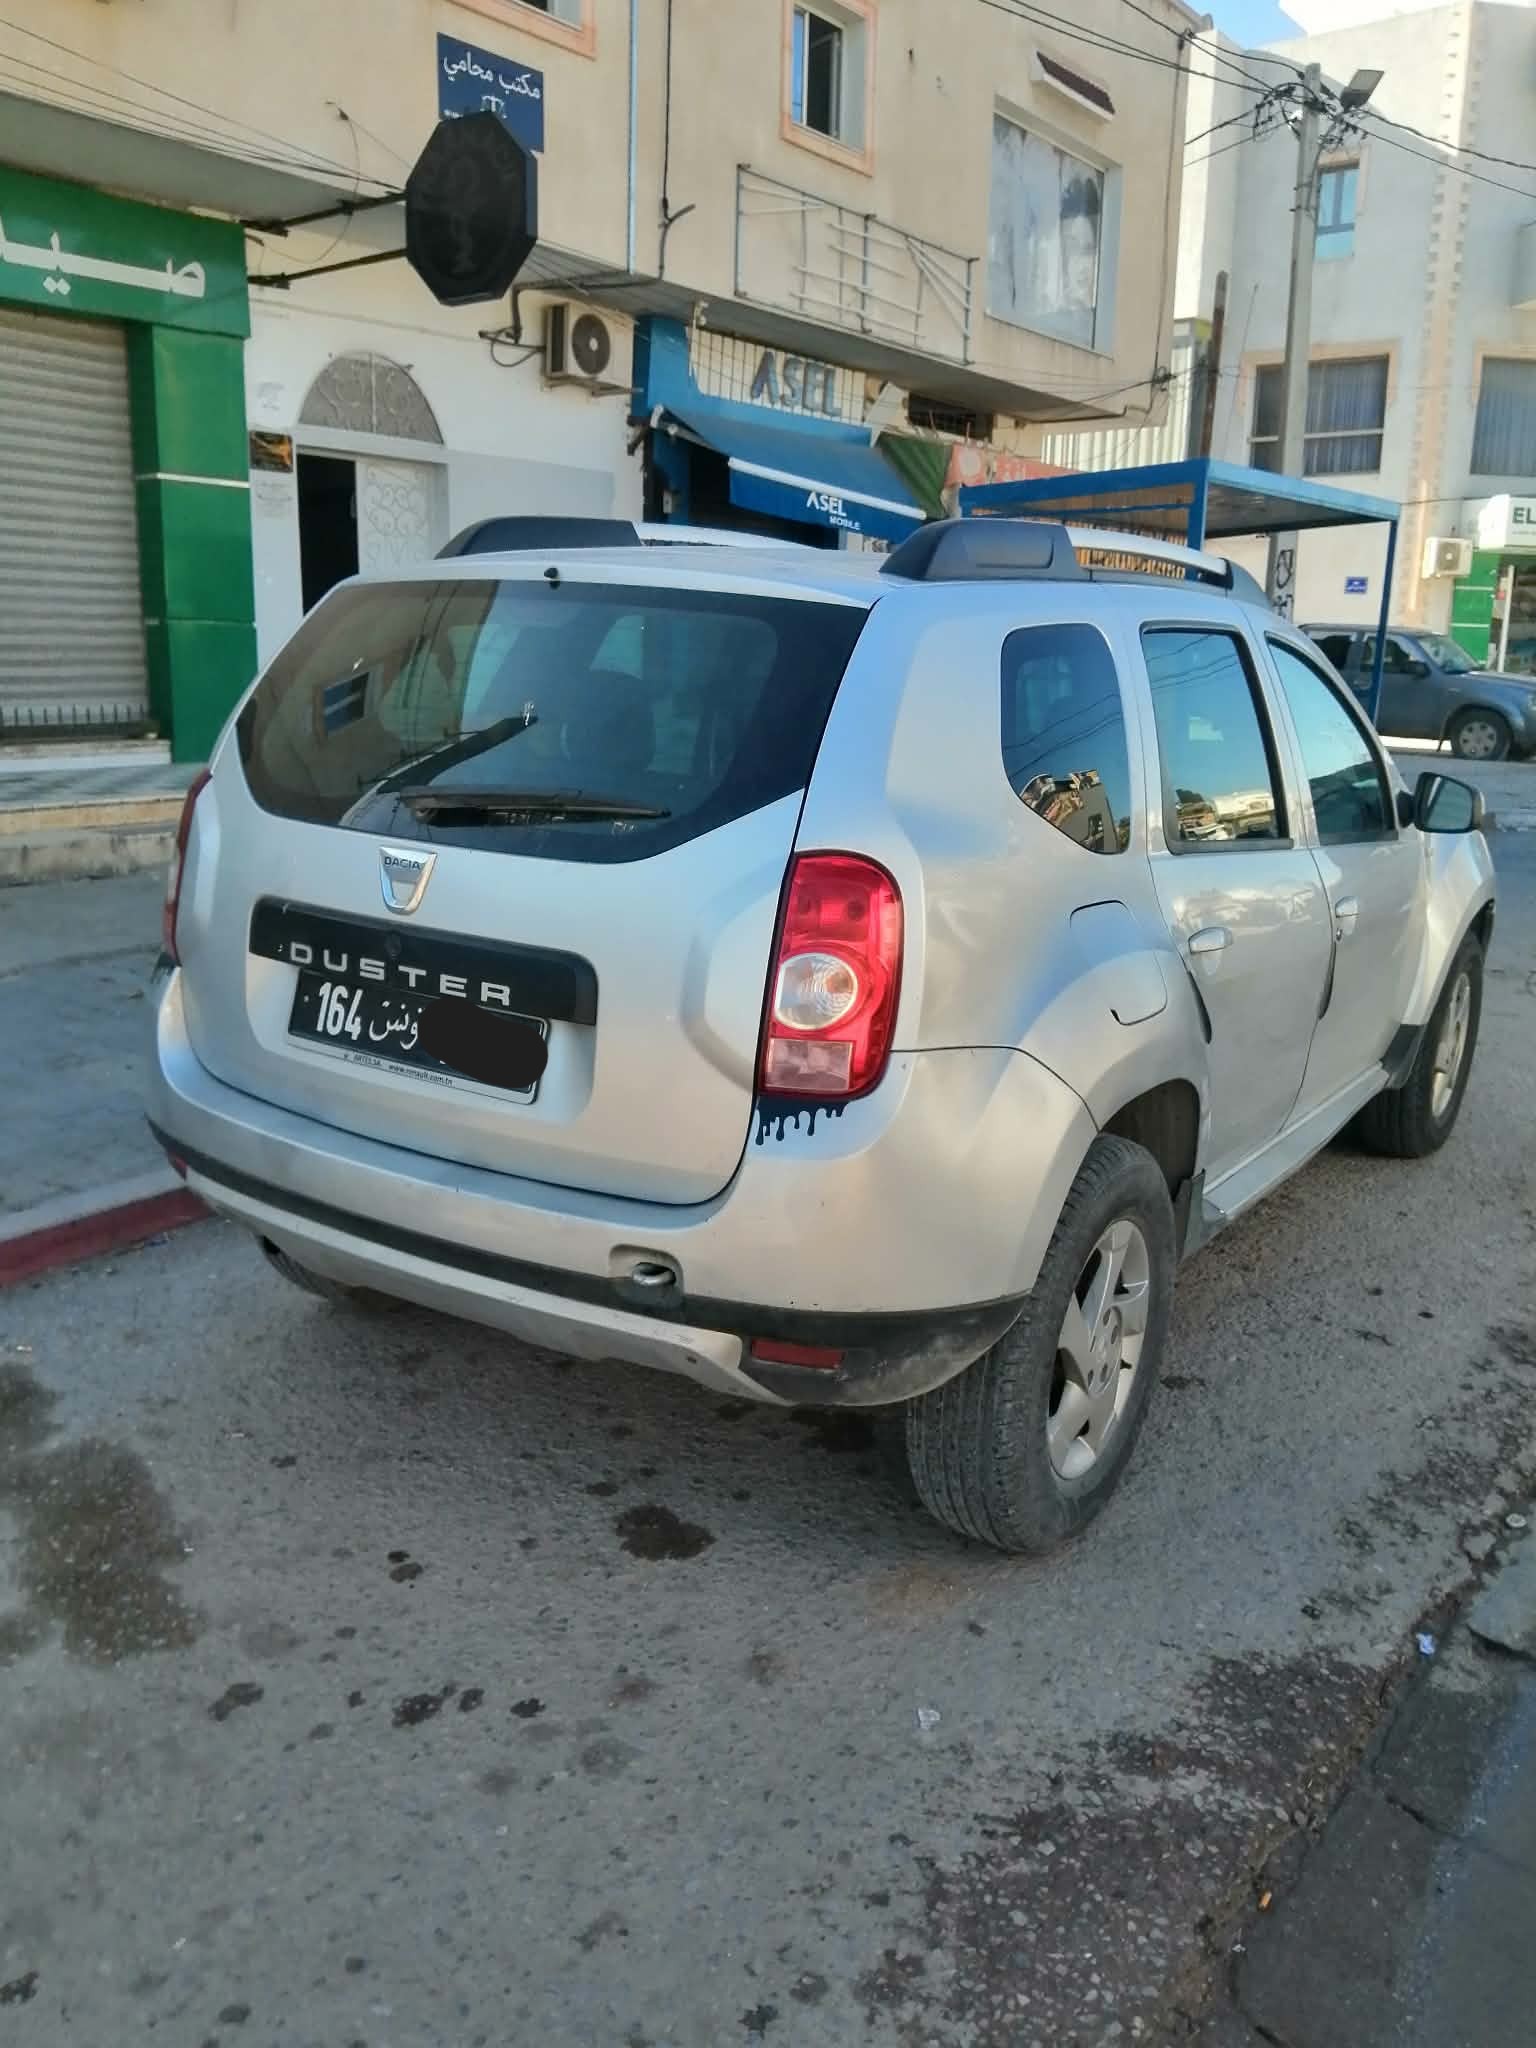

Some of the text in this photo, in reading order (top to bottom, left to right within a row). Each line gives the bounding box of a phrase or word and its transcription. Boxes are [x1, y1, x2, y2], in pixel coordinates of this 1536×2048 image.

[443, 51, 540, 99] مكتب محامي
[751, 351, 842, 417] ASEL
[806, 491, 847, 517] ASEL
[384, 856, 421, 870] DACIA
[290, 941, 511, 1006] DUSTER
[316, 982, 363, 1041] 164
